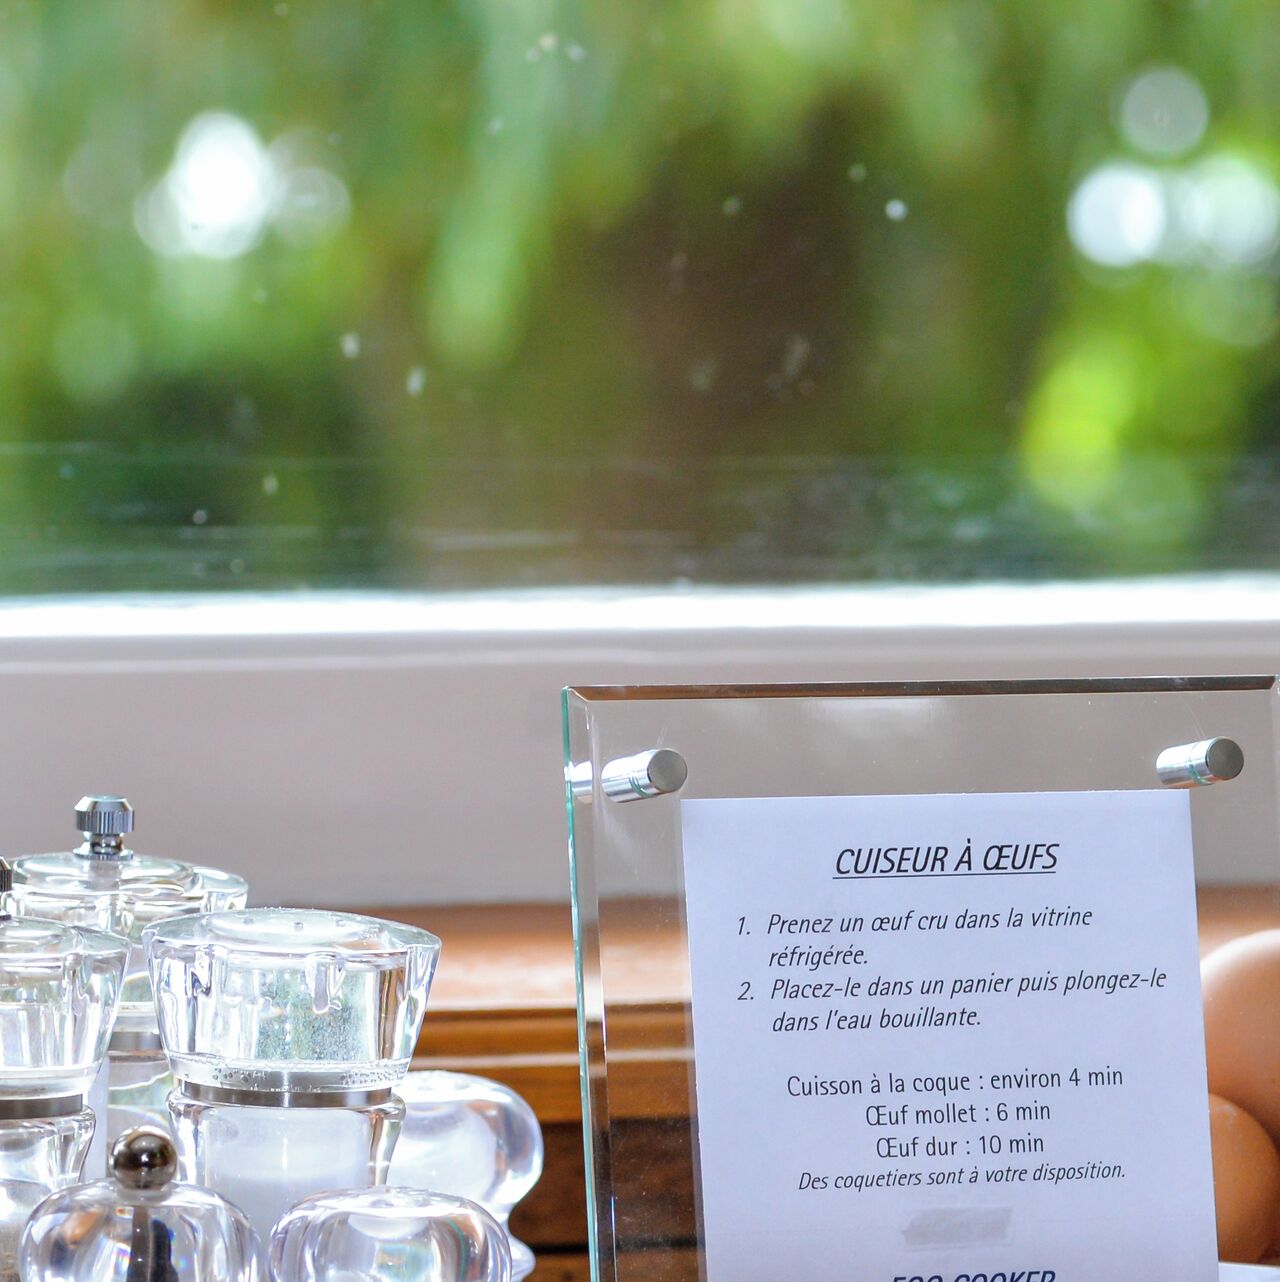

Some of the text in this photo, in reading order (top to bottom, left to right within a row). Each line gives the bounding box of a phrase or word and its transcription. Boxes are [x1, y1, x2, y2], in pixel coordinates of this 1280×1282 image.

[835, 837, 1061, 875] CUISEUR À ŒUFS
[738, 905, 1093, 936] 1. Prenez un œuf cru dans la vitrine
[768, 943, 868, 972] réfrigérée.
[736, 967, 1167, 1001] 2. Placez-le dans un panier puis plongez-le
[772, 1005, 981, 1033] dans l'eau bouillante.
[787, 1064, 1123, 1098] Cuisson à la coque : environ 4 min
[865, 1099, 1051, 1127] Œuf mollet : 6 min
[876, 1131, 1044, 1159] Œuf dur : 10 min
[798, 1160, 1126, 1193] Des coquetiers sont à votre disposition.
